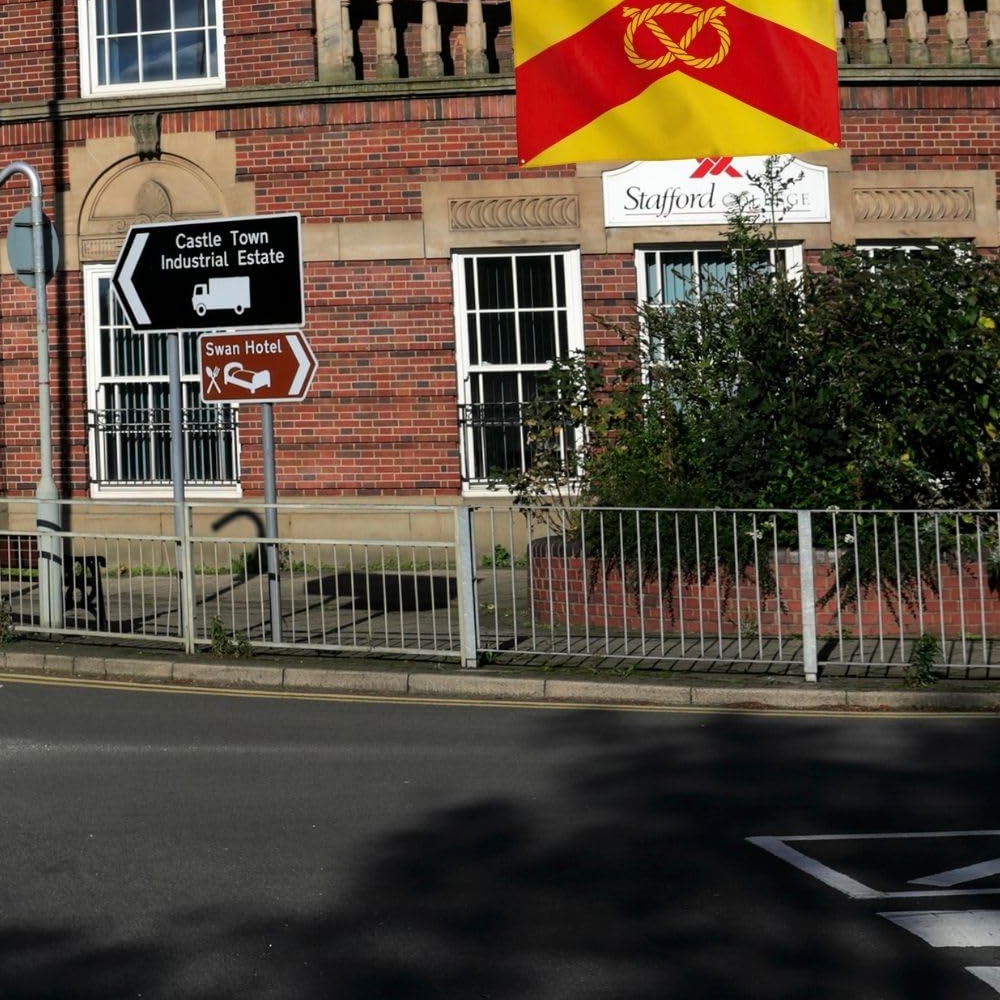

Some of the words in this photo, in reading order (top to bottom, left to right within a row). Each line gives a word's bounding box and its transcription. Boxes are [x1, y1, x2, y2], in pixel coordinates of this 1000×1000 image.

[623, 182, 716, 218] Stafford
[175, 231, 222, 249] Castle
[229, 230, 269, 246] Town
[161, 250, 229, 270] Industrial
[238, 248, 285, 266] Estate
[205, 342, 240, 356] Swan
[245, 339, 282, 354] Hotel
